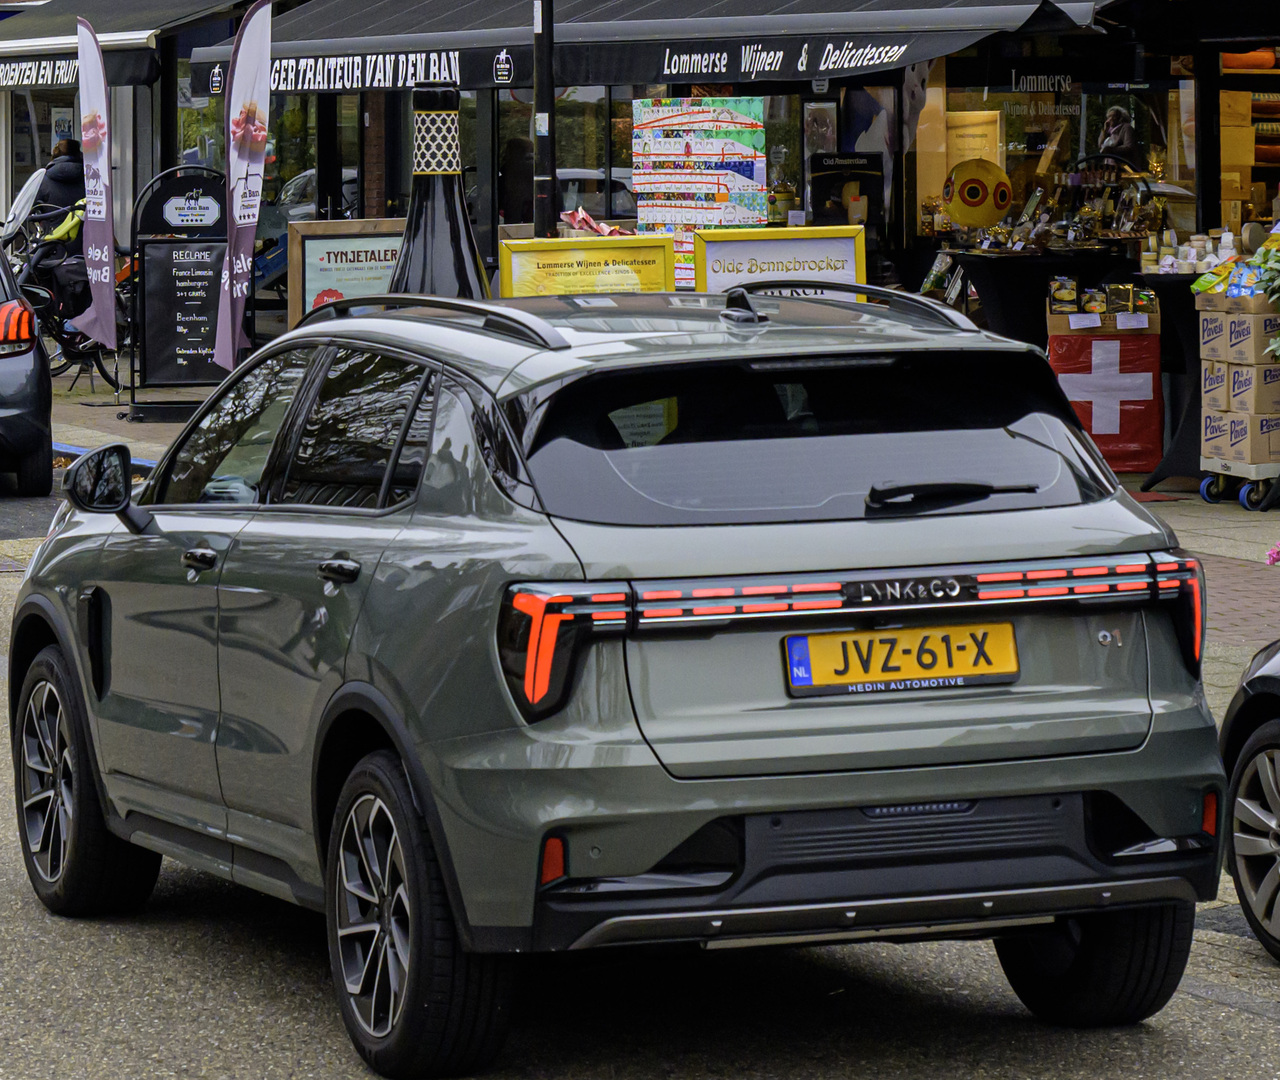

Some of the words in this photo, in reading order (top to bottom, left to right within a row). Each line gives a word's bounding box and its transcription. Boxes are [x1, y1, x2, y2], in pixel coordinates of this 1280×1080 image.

[663, 48, 729, 75] Lommerse
[741, 44, 785, 79] Wijnen
[797, 43, 809, 71] &
[819, 41, 908, 71] Delicatessen
[38, 60, 54, 85] EN
[54, 59, 79, 85] FRUIT
[270, 58, 296, 91] GER
[296, 55, 362, 90] TRAITEUR
[365, 53, 394, 88] VAN
[397, 52, 426, 87] DEN
[429, 50, 460, 86] BAN
[1011, 69, 1072, 93] Lommerse
[1003, 100, 1029, 116] Wijnen
[1029, 102, 1037, 116] &
[1038, 101, 1081, 116] Delicatessen
[822, 157, 834, 165] Old
[834, 157, 868, 165] Amsterdam
[172, 250, 211, 260] RECLAME
[325, 249, 398, 264] TYNJETALER
[536, 262, 575, 270] Lommerse
[575, 260, 602, 269] Wijnen
[612, 258, 657, 267] Delicatessen
[711, 258, 744, 275] Olde
[747, 255, 848, 274] Bennebroeker
[172, 268, 191, 277] France
[176, 280, 209, 289] hamburgers
[176, 312, 208, 322] Beenham
[1202, 318, 1224, 340] Pavesi
[1229, 320, 1252, 343] Pavesi
[1232, 370, 1253, 392] Pavesi
[1230, 420, 1248, 442] Pavesi
[1098, 628, 1123, 648] 01
[833, 631, 994, 677] JVZ-61-X
[793, 666, 809, 678] NL
[848, 683, 886, 693] HEDIN
[890, 677, 965, 690] AUTOMOTIVE
